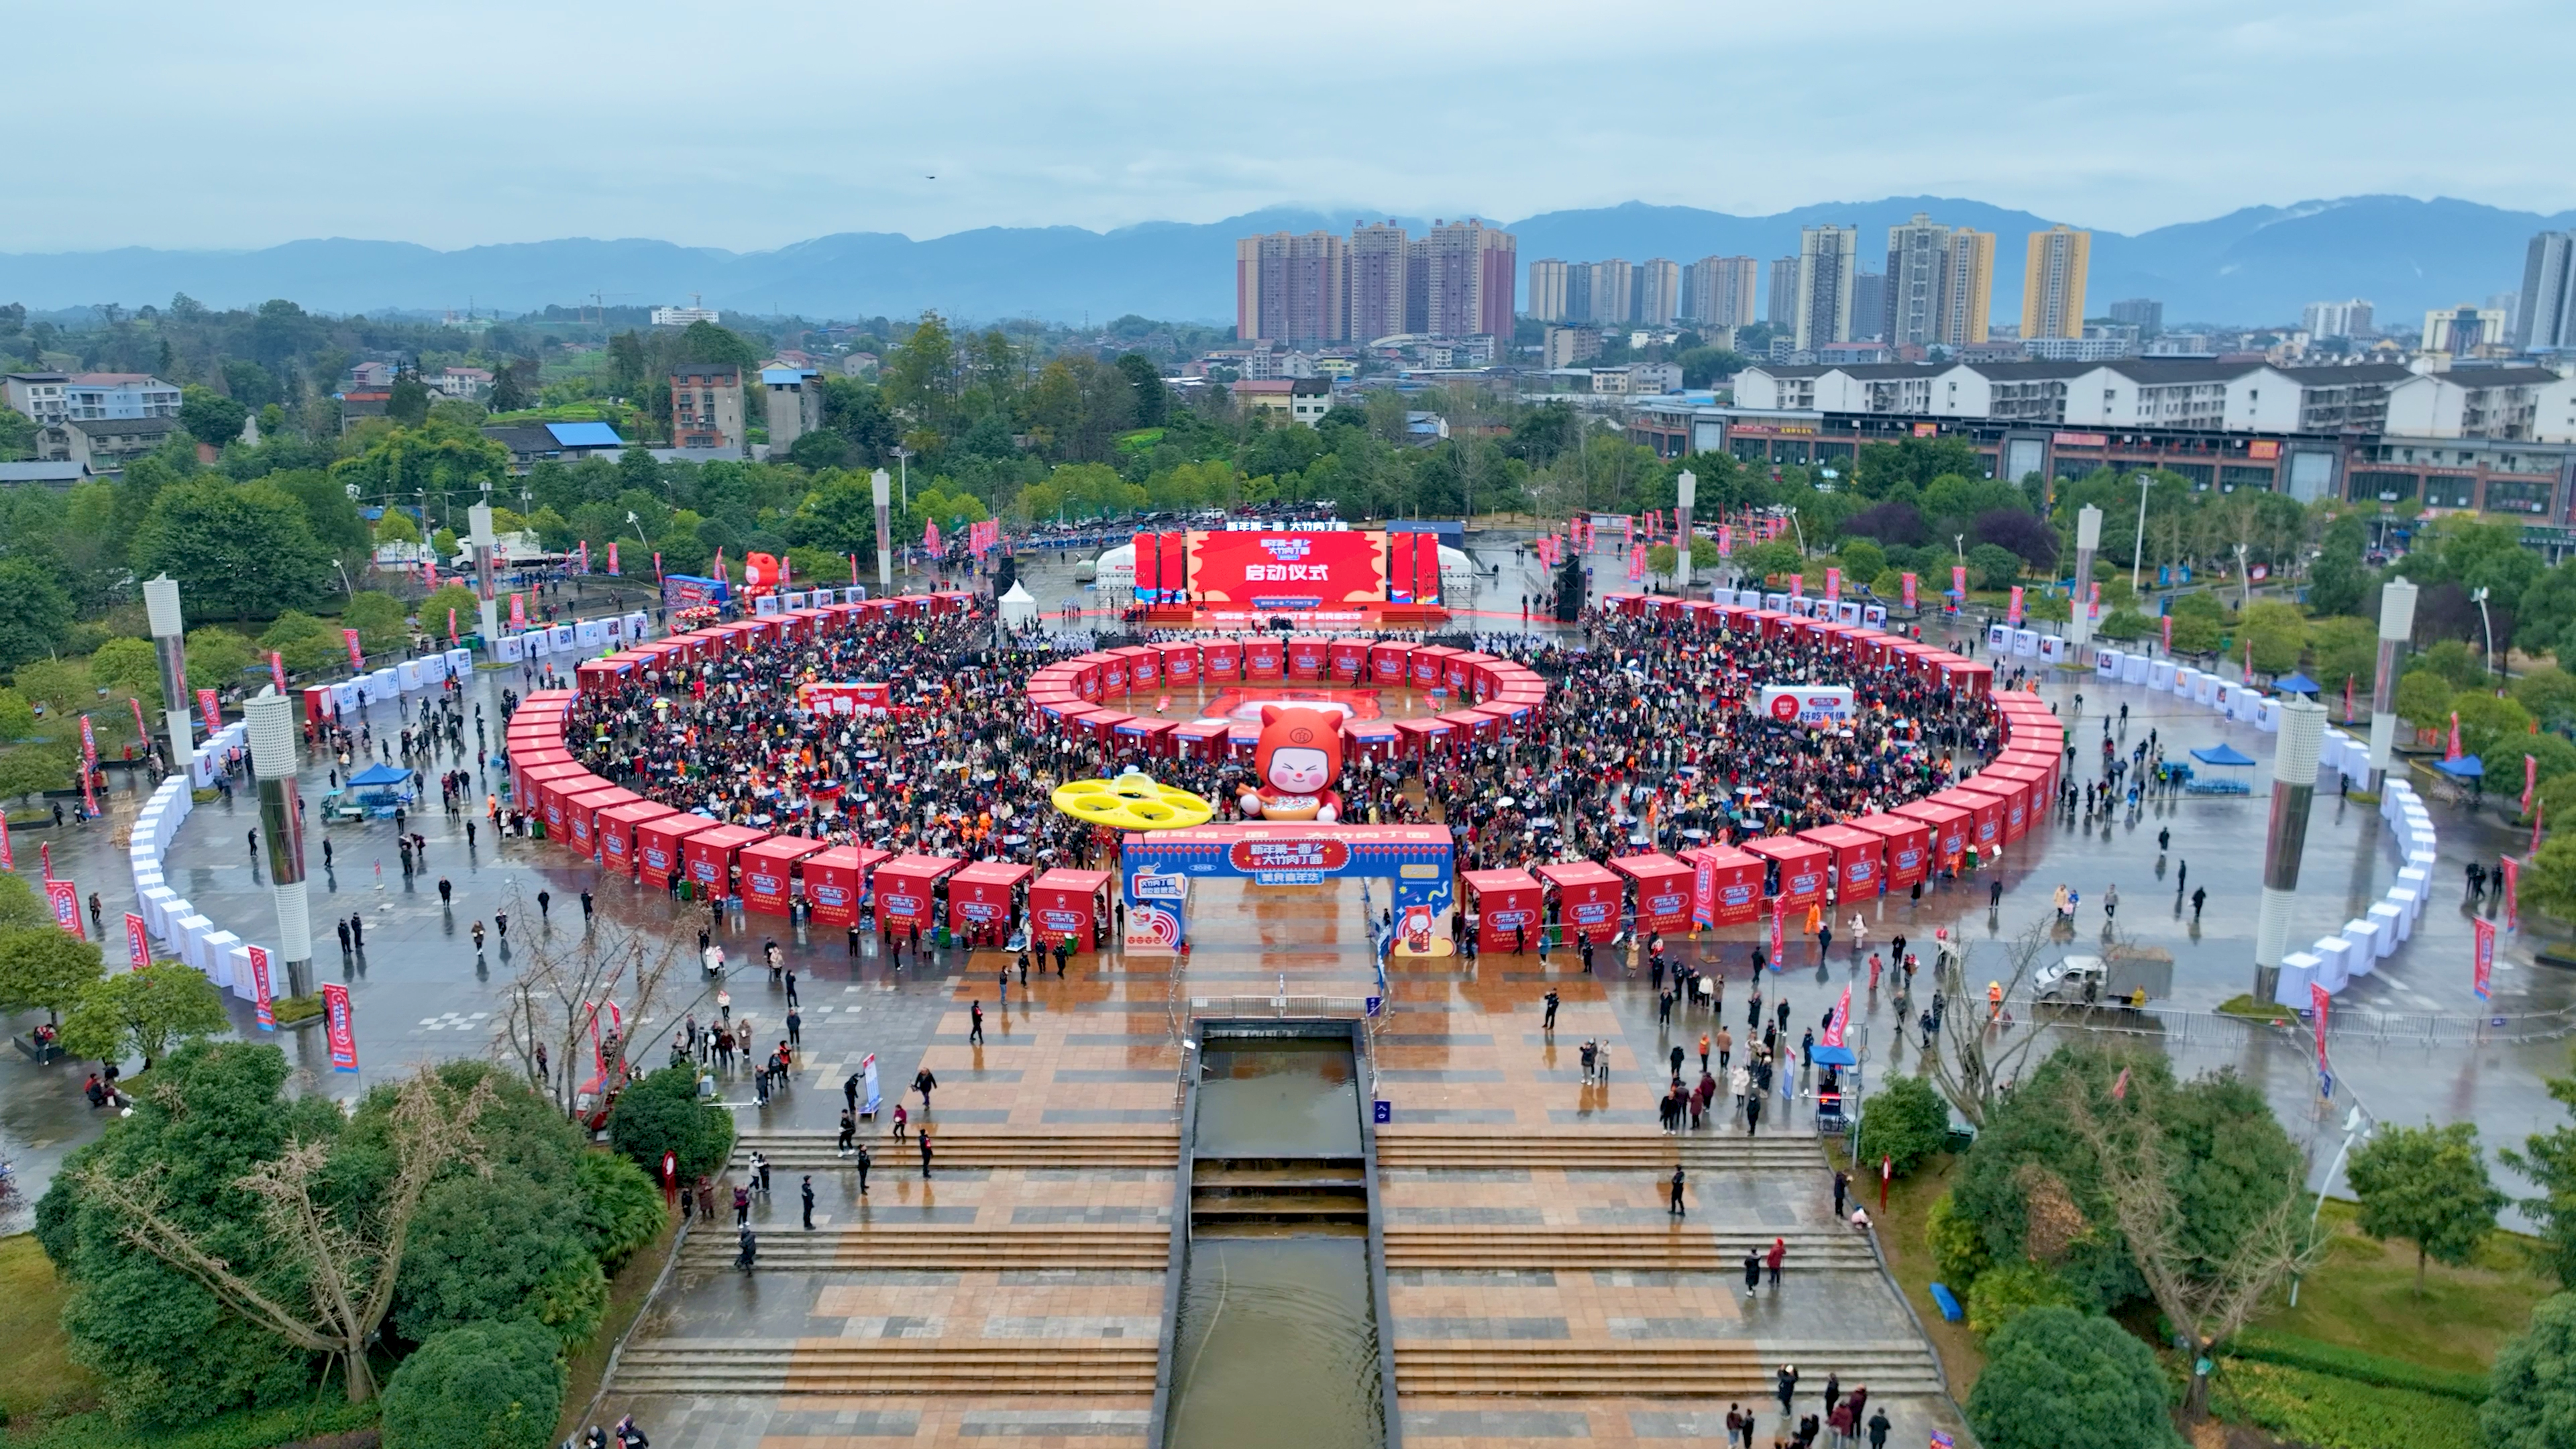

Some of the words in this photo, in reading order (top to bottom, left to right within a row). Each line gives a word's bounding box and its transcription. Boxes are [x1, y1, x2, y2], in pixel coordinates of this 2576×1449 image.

[1226, 522, 1284, 531] 新年第一面
[1289, 522, 1348, 531] 大竹肉丁面
[1246, 564, 1328, 581] 启动仪式
[1250, 844, 1311, 856] 新年第一面
[1263, 854, 1323, 865] 大竹肉丁面
[1261, 873, 1320, 882] 美食嘉年华
[1377, 1105, 1387, 1119] 入口
